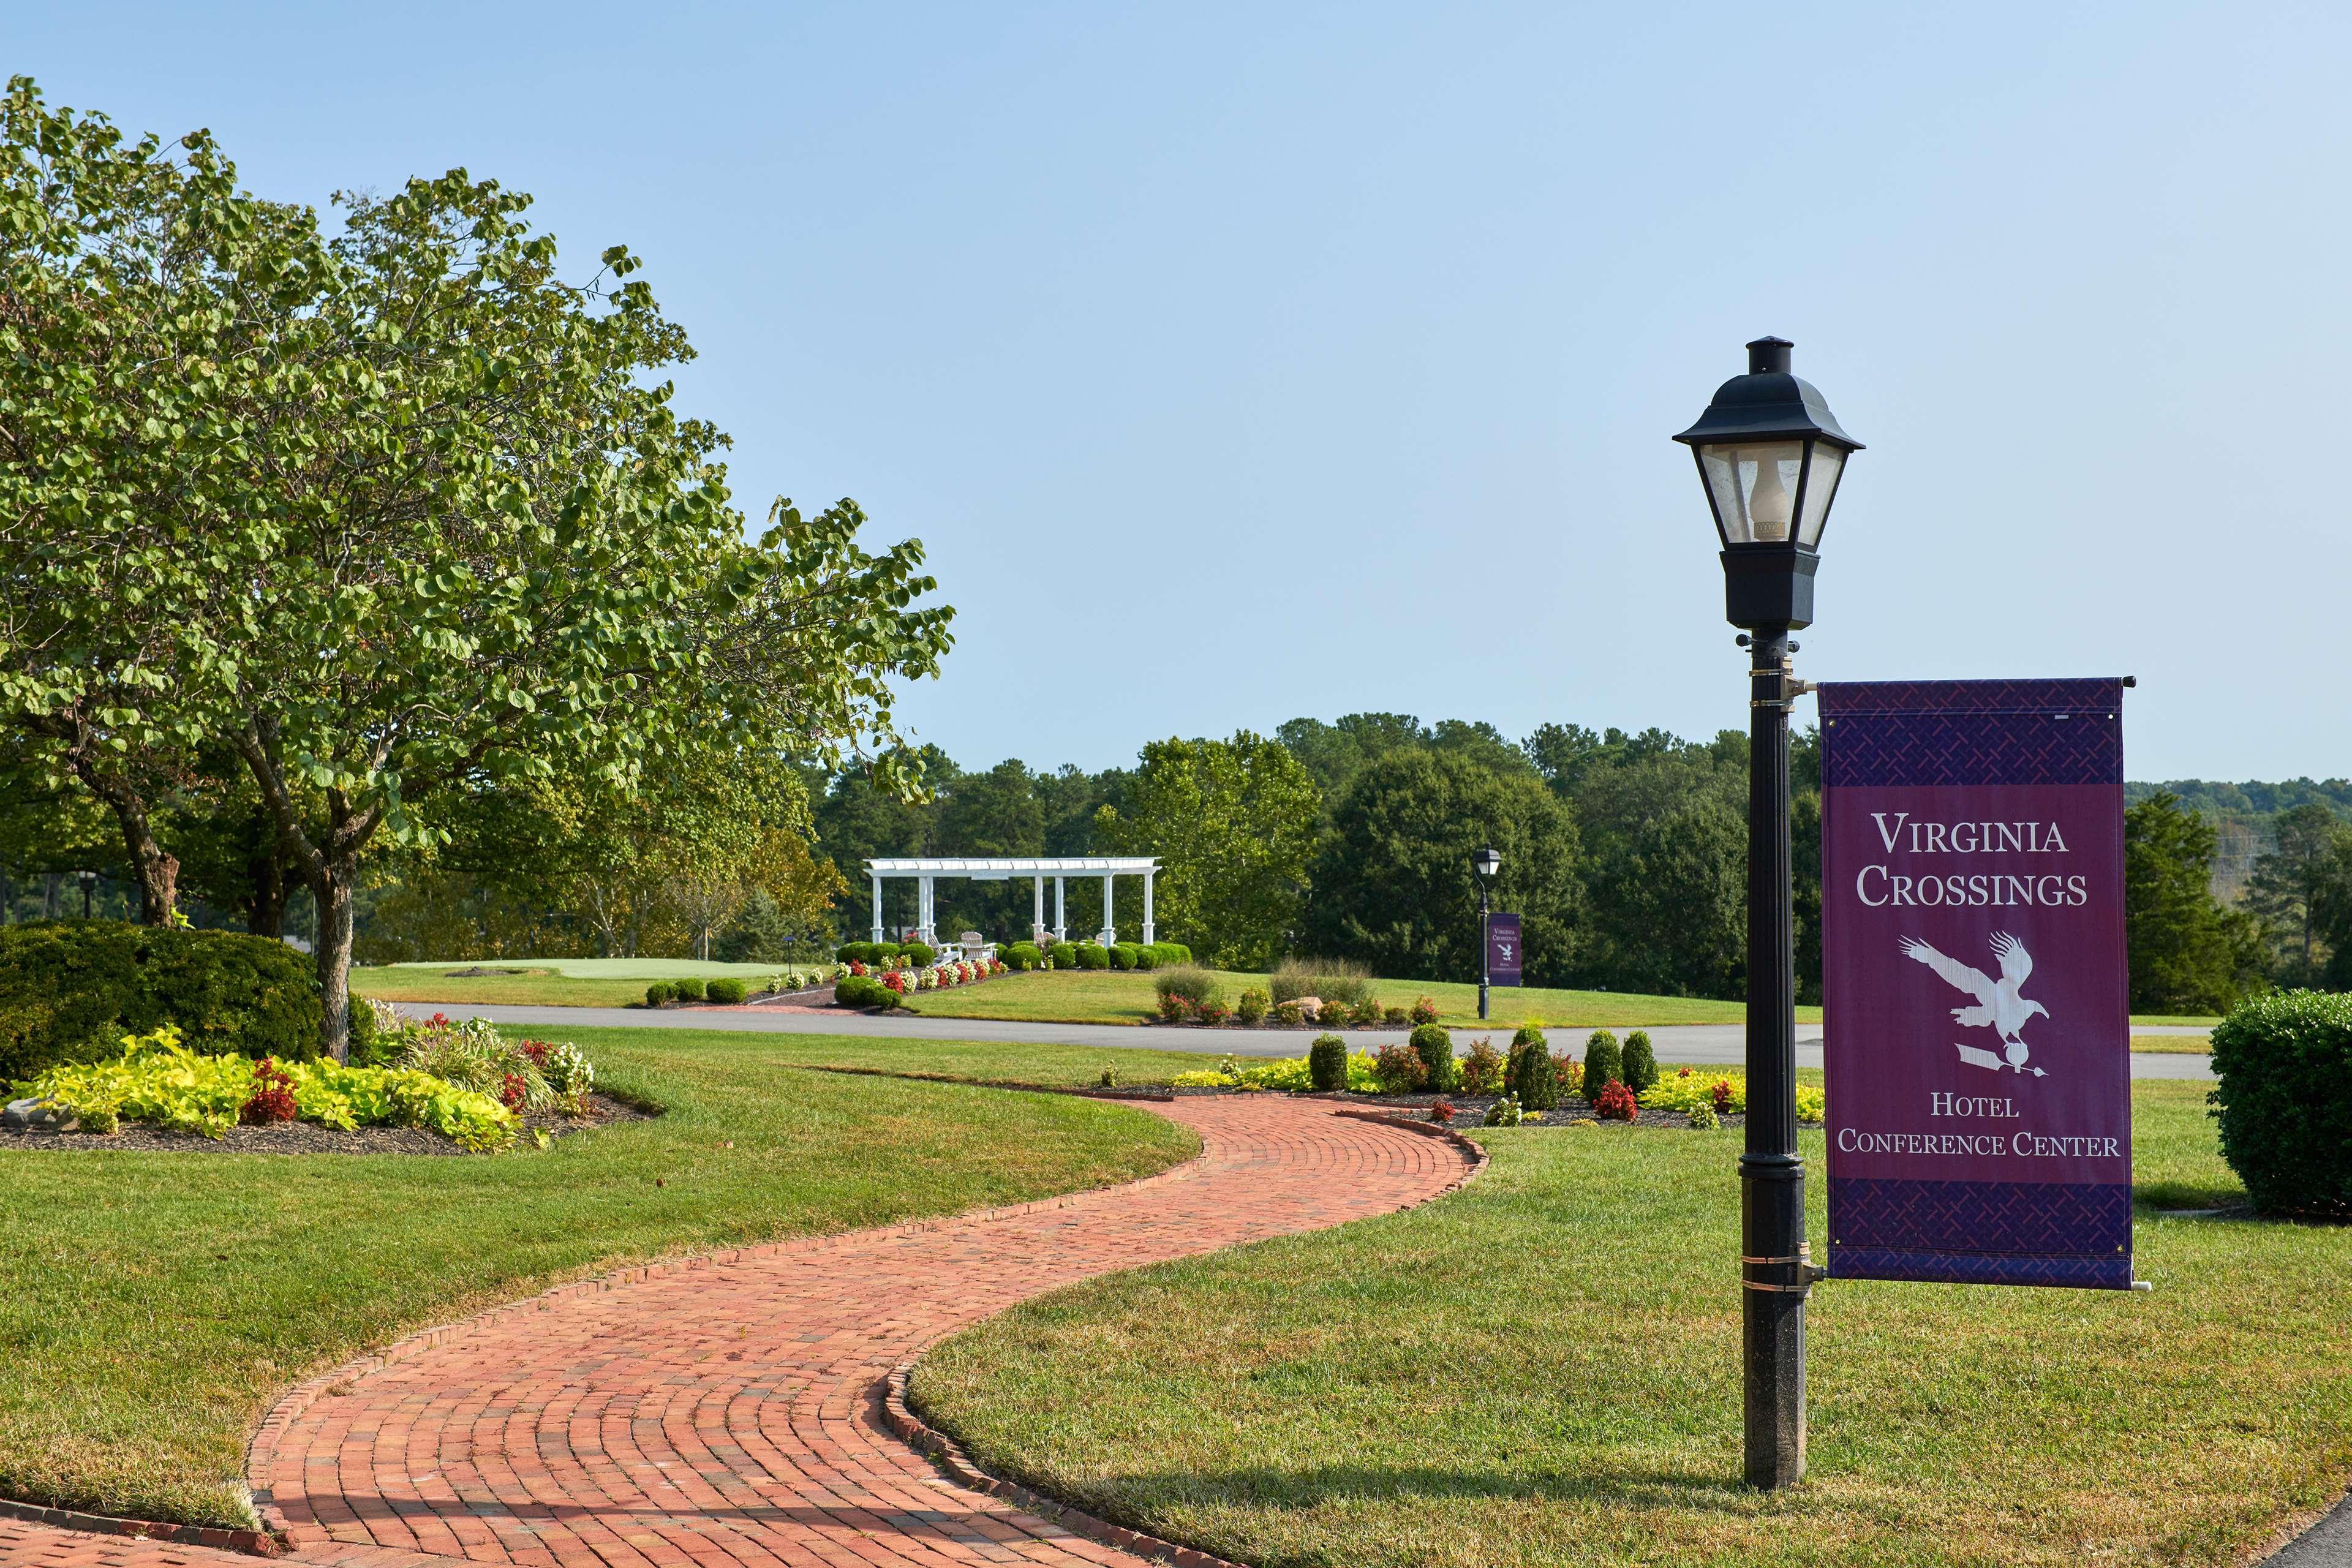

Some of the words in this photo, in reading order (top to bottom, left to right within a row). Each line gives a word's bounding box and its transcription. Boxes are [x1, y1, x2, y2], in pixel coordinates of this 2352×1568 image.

[1871, 812, 2069, 853] VIRGINIA
[1856, 865, 2087, 907] CROSSINGS
[1931, 1092, 2019, 1117] HOTEL
[1838, 1128, 2006, 1155] CONFERENCE
[2013, 1132, 2121, 1157] CENTER
